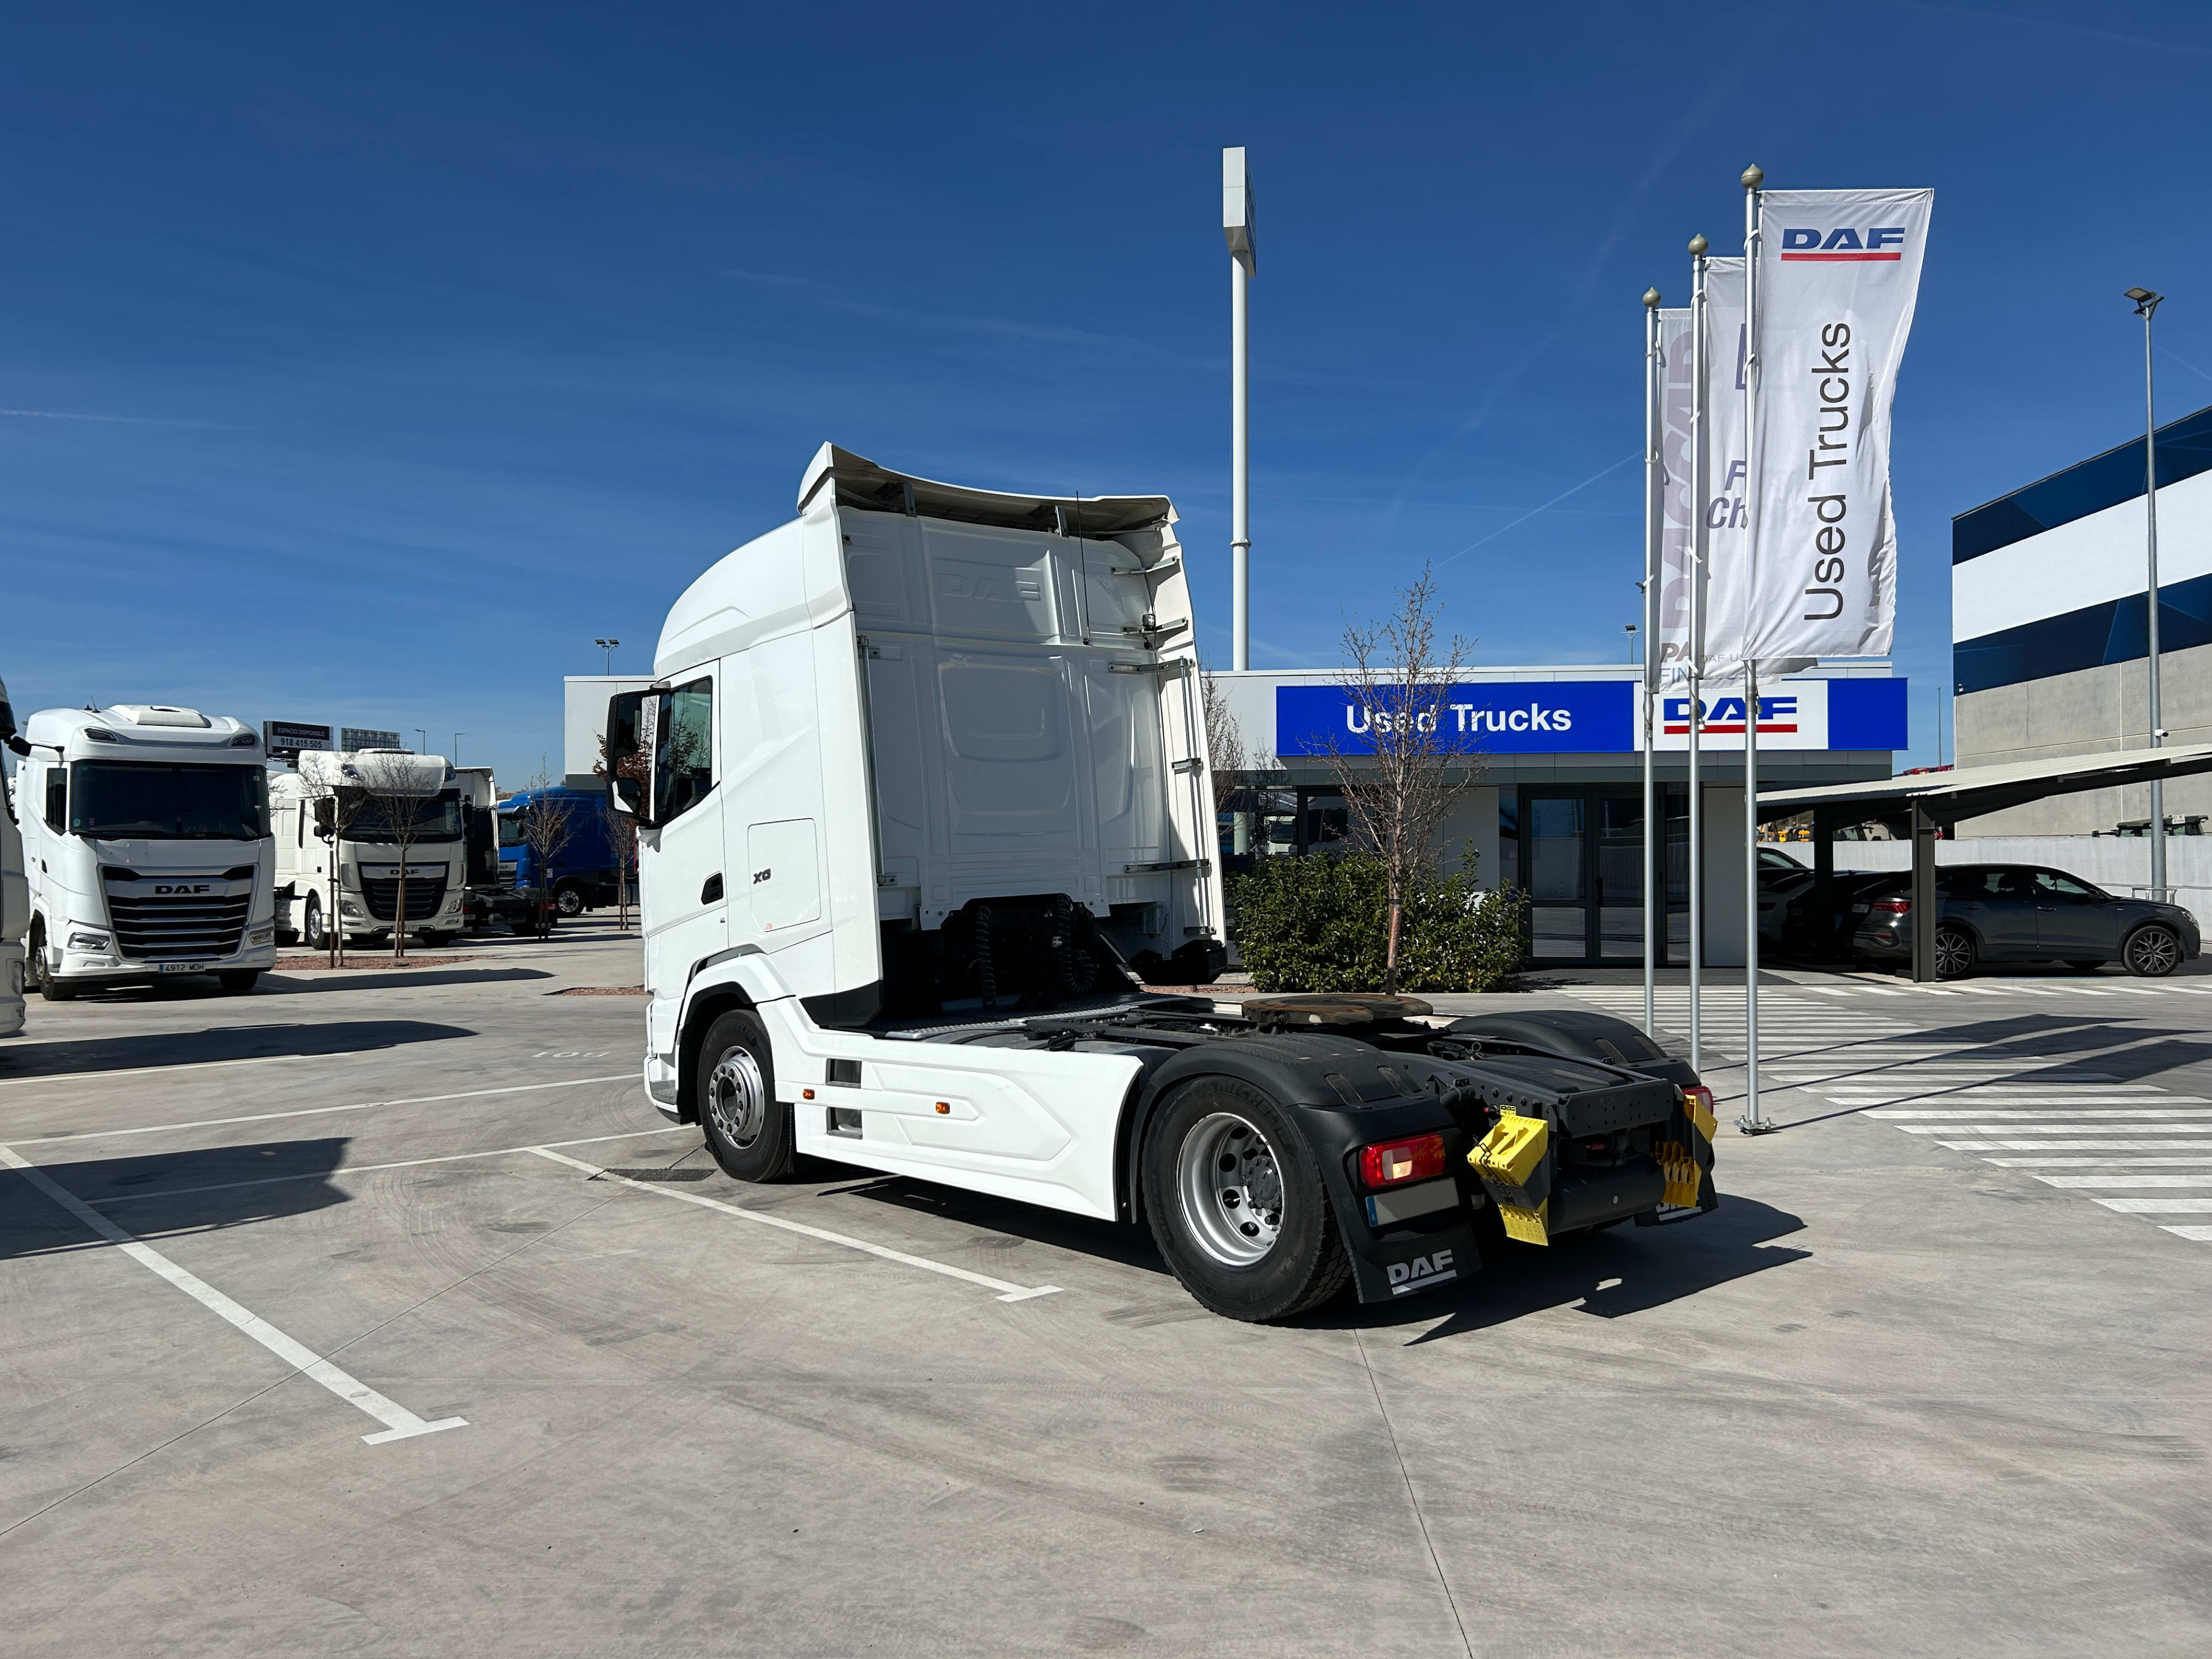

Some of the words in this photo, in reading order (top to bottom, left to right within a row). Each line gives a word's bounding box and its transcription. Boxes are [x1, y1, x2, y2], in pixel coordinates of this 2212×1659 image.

[1782, 227, 1906, 249] DAF
[1808, 323, 1851, 480] Trucks
[1804, 494, 1847, 620] Used
[1346, 704, 1437, 733] Used
[1449, 703, 1571, 732] Trucks
[1663, 696, 1797, 721] DAF
[281, 737, 293, 746] 918
[296, 739, 308, 747] 415
[310, 740, 322, 748] 505
[155, 885, 210, 894] DAF
[165, 964, 185, 972] 4912
[1386, 1249, 1453, 1285] DAF
